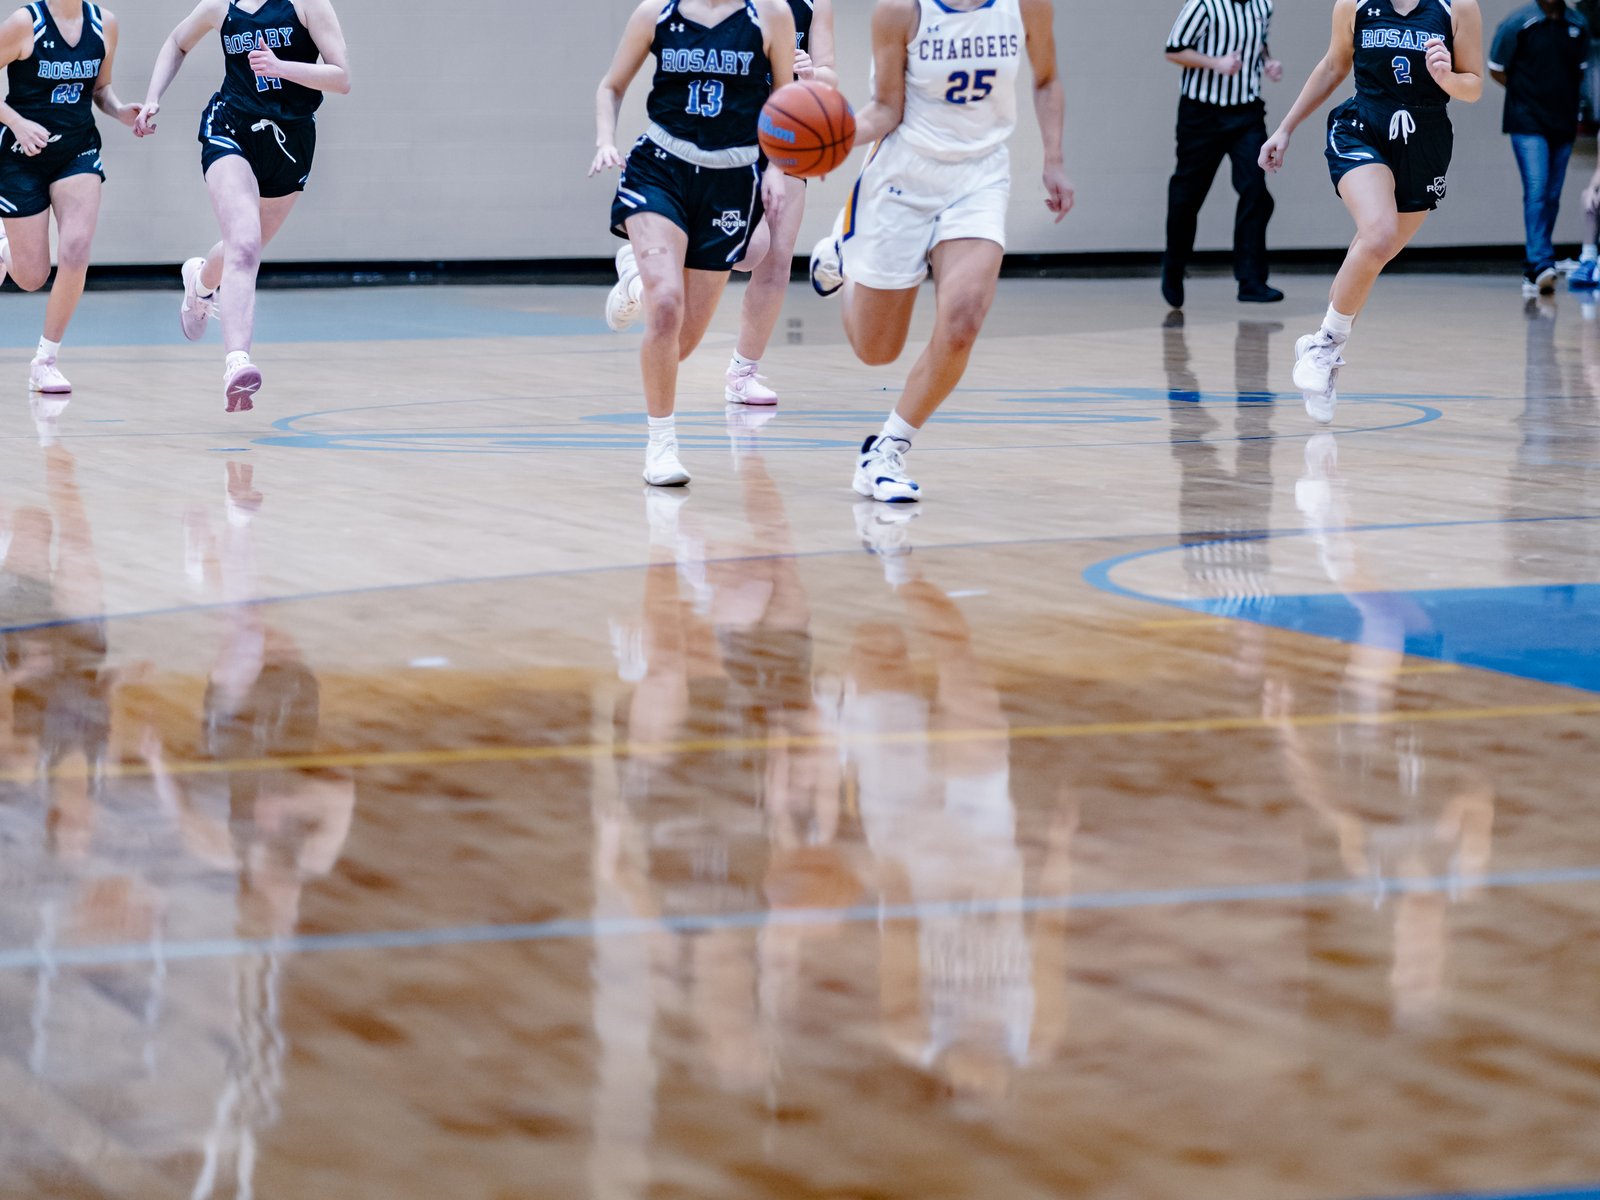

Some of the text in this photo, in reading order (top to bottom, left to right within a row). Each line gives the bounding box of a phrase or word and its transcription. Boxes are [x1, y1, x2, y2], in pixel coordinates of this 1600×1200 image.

[919, 34, 1018, 61] CHARGERS
[38, 58, 101, 80] ROSARY
[661, 48, 754, 75] ROSARY
[1391, 55, 1412, 84] 2
[685, 79, 724, 118] 13
[945, 68, 997, 105] 25
[712, 218, 747, 229] Royals
